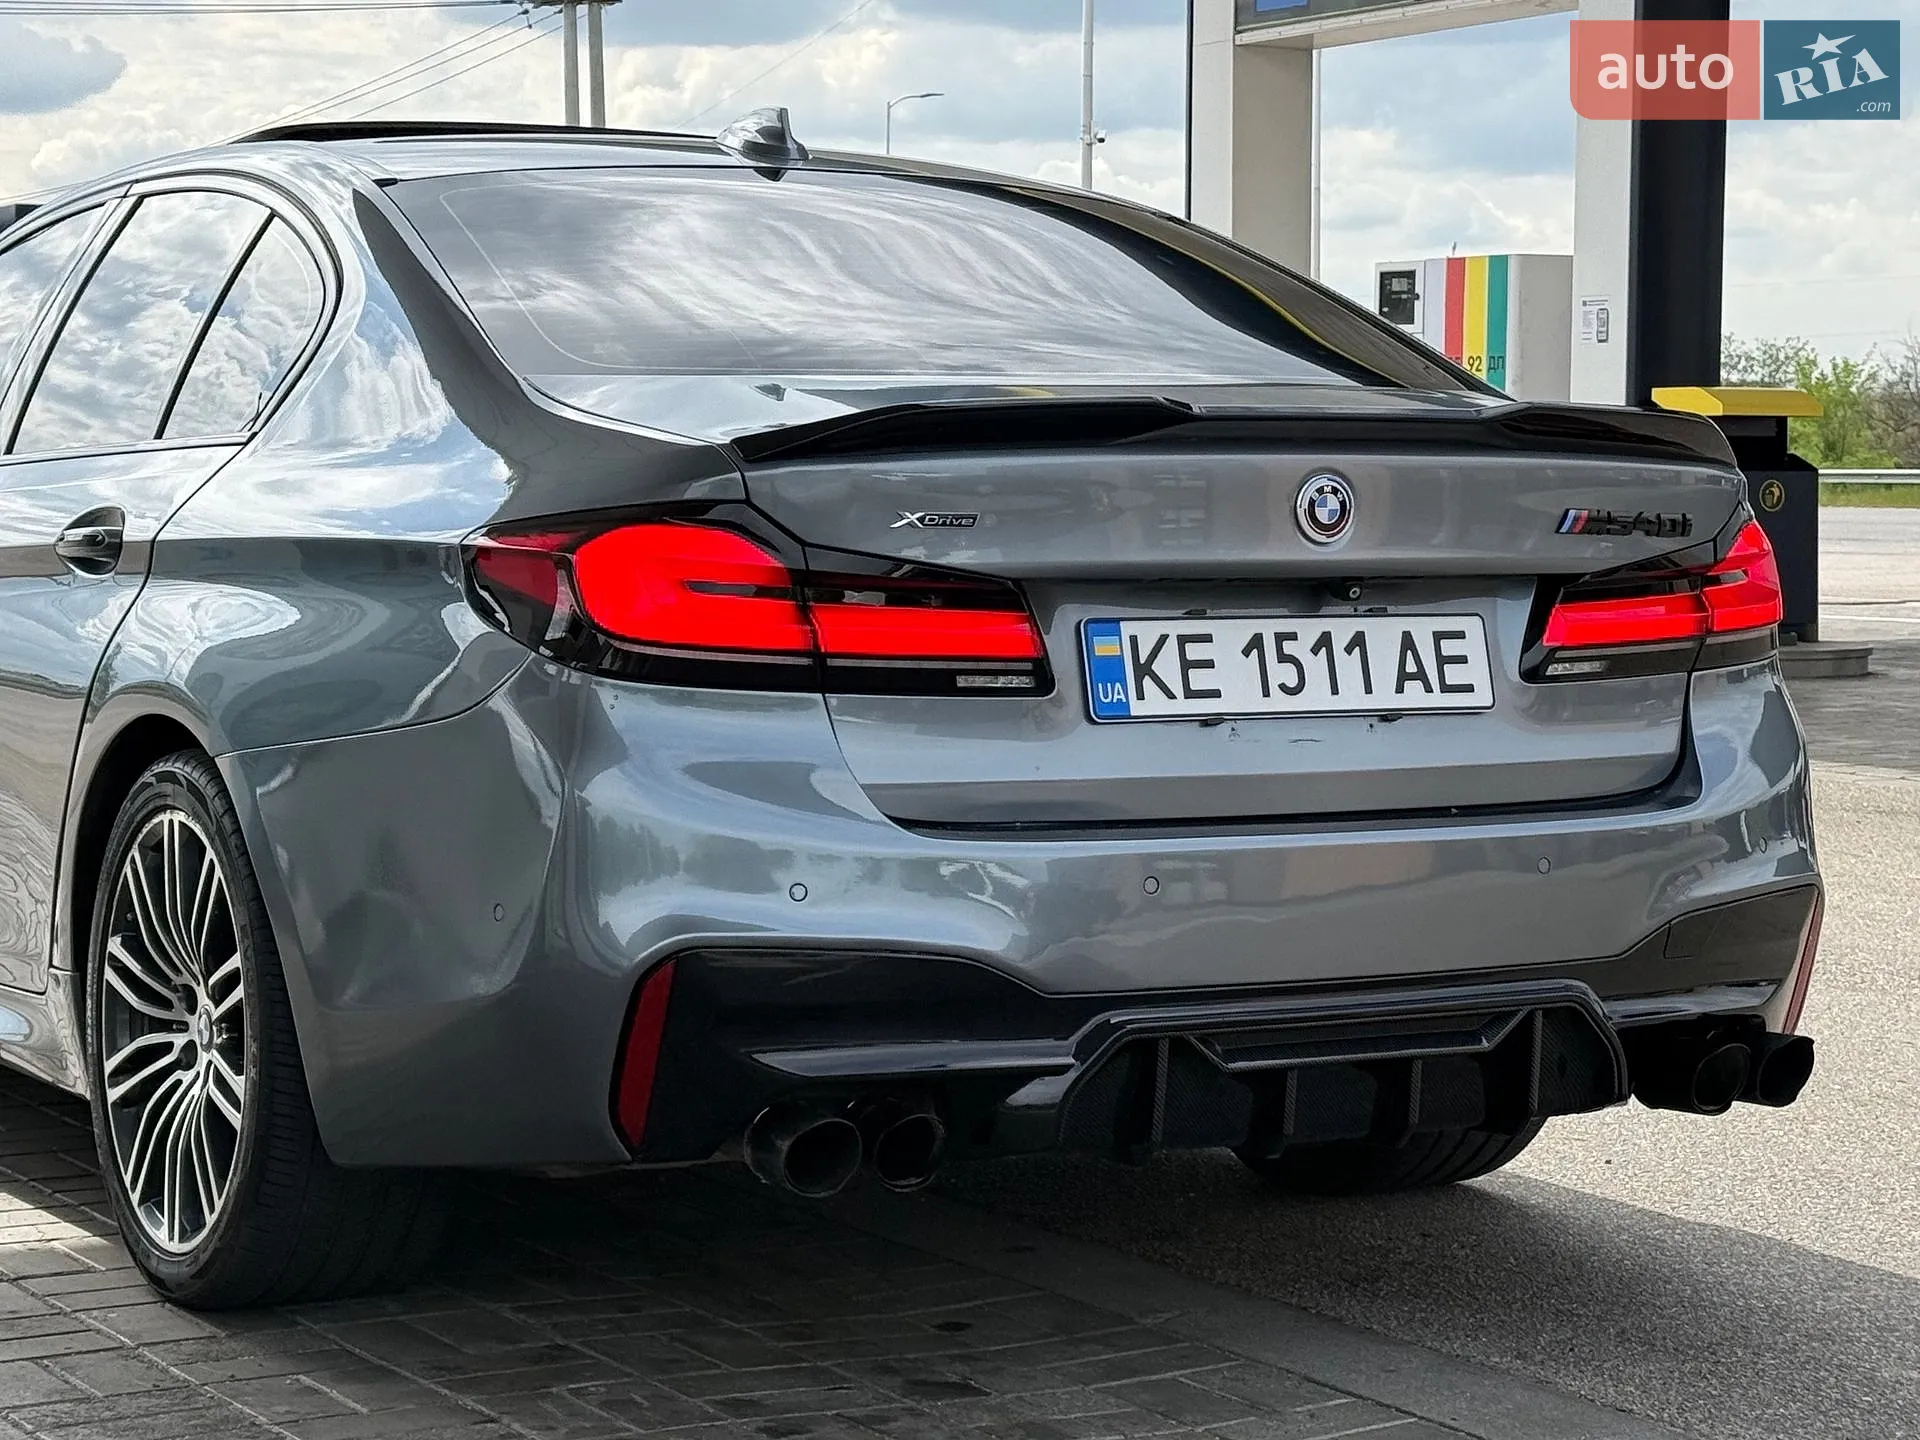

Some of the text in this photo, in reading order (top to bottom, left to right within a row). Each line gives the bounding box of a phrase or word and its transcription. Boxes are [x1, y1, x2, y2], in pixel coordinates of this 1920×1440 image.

[1467, 355, 1483, 372] 92
[1311, 485, 1345, 502] BMW
[1129, 629, 1475, 701] KE 1511 AE
[1097, 682, 1127, 704] UA
